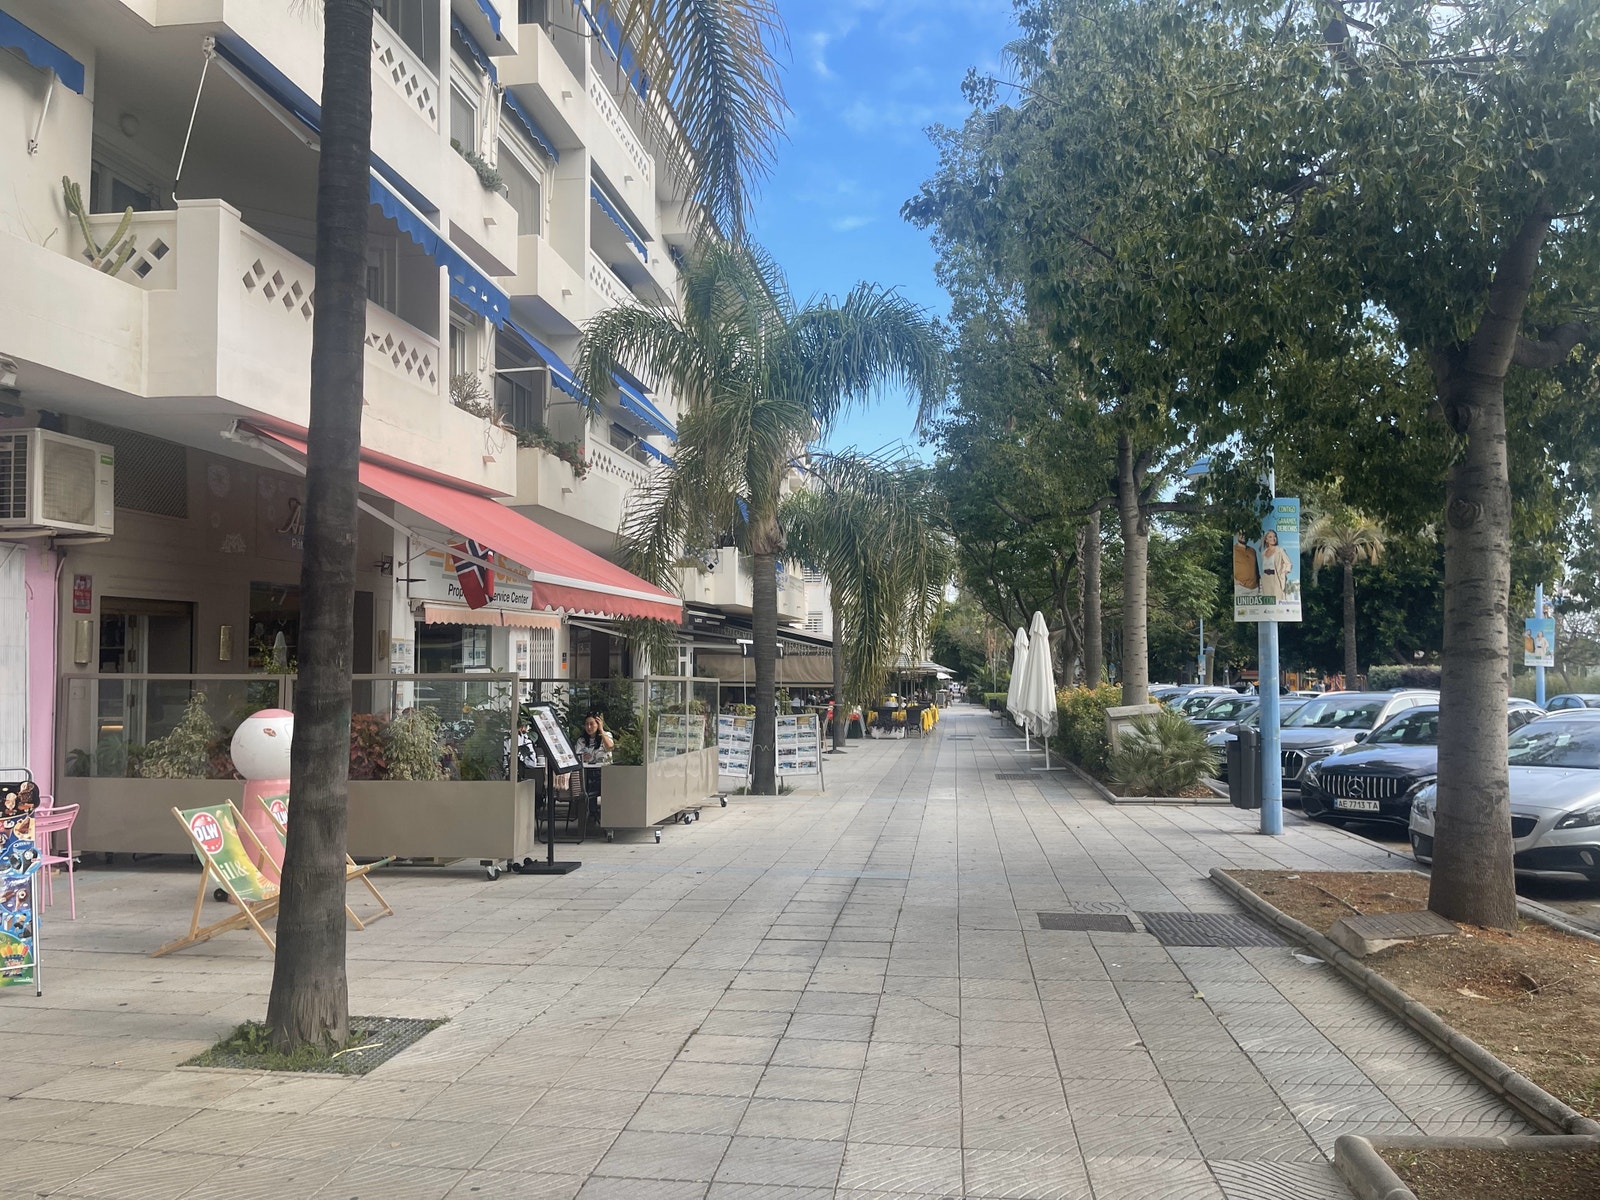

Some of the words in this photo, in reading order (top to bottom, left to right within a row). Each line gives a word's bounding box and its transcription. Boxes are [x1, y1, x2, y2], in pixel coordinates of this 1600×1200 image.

[493, 590, 510, 603] ervice
[510, 591, 529, 605] Center
[1237, 595, 1263, 605] UNIDAS
[1349, 801, 1365, 809] 7713
[193, 823, 219, 842] OLW
